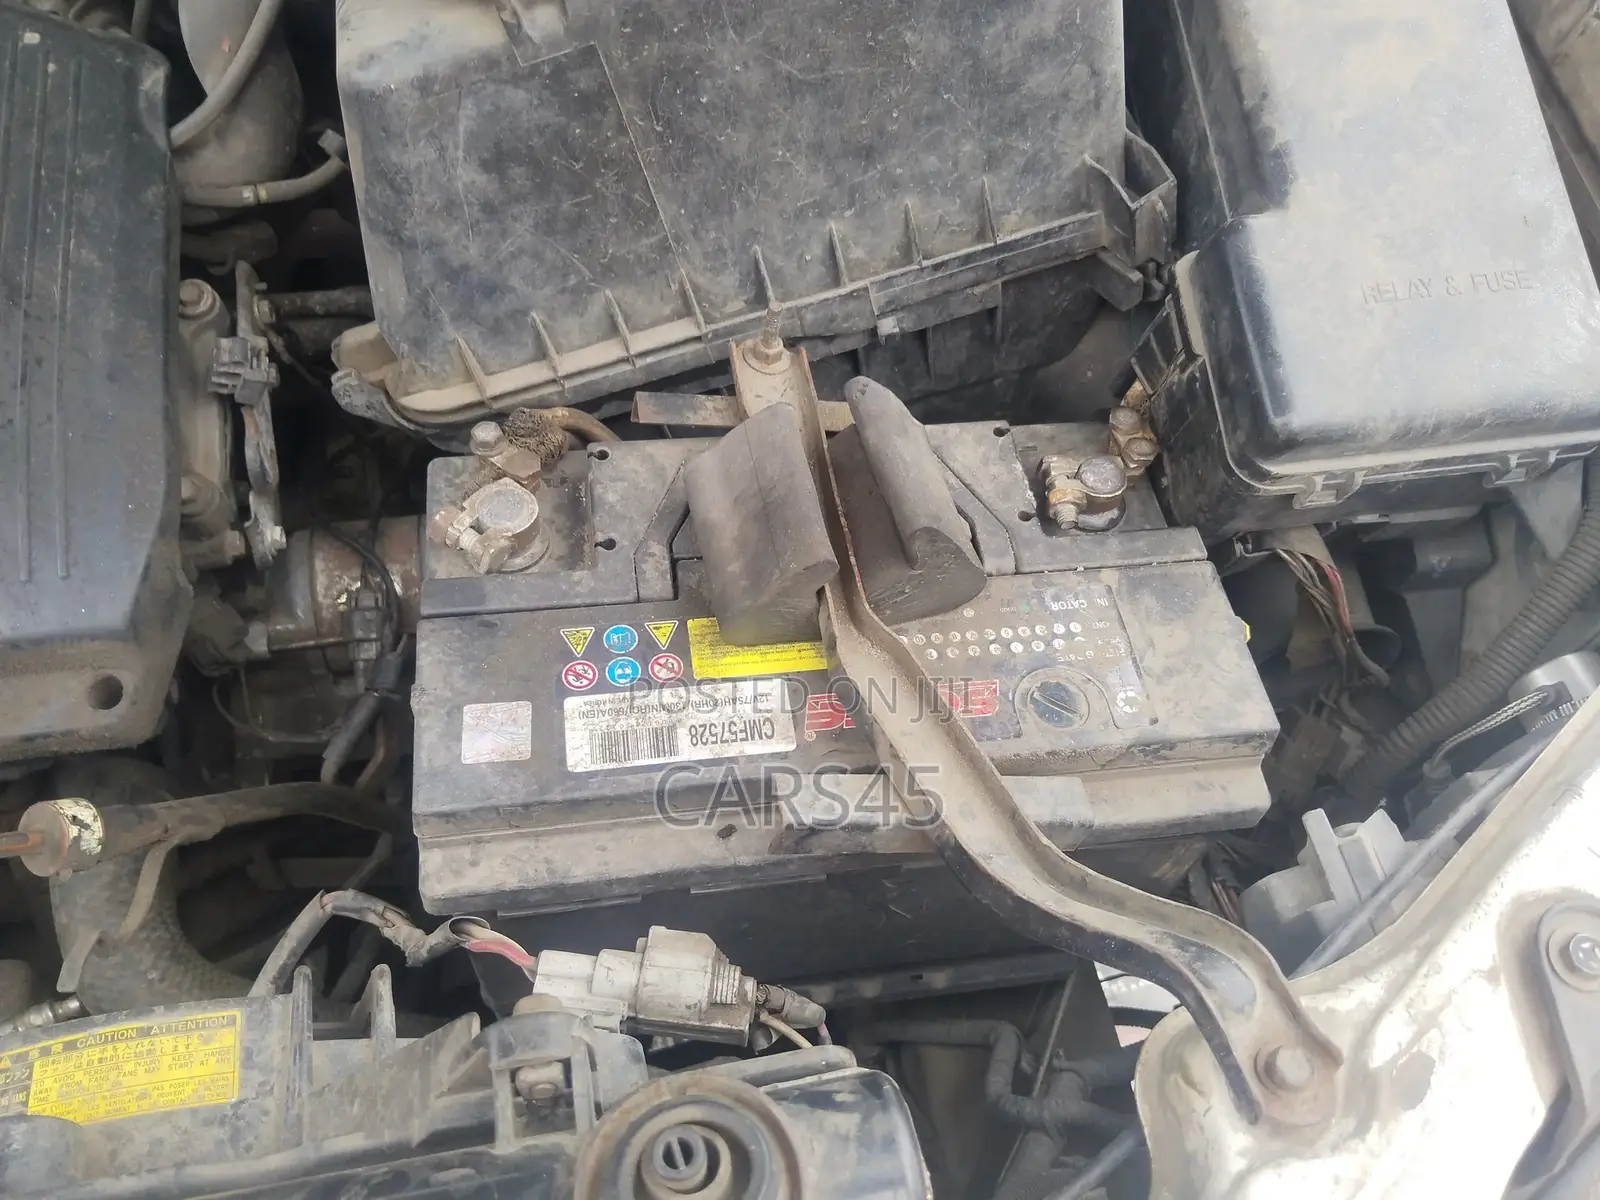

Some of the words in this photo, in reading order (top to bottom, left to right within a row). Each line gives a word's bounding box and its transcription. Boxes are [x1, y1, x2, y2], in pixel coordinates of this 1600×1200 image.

[1361, 276, 1432, 304] RELAY
[1445, 275, 1464, 296] &
[1470, 269, 1533, 293] FUSE
[689, 717, 775, 747] CMF57528
[77, 1028, 137, 1048] CAUTION
[151, 1016, 228, 1035] ATTENTION
[36, 1080, 45, 1089] TO
[52, 1073, 75, 1084] AVOID
[84, 1064, 124, 1076] PERSONAL
[134, 1057, 162, 1068] INJURY
[172, 1053, 194, 1063] KEEP
[204, 1049, 231, 1059] HANDS
[60, 1080, 83, 1089] FROM
[89, 1075, 109, 1085] FANS
[117, 1069, 138, 1079] FANS
[168, 1060, 194, 1071] START
[199, 1059, 209, 1067] AT
[216, 1056, 231, 1065] ANY
[169, 1081, 190, 1090] POSER
